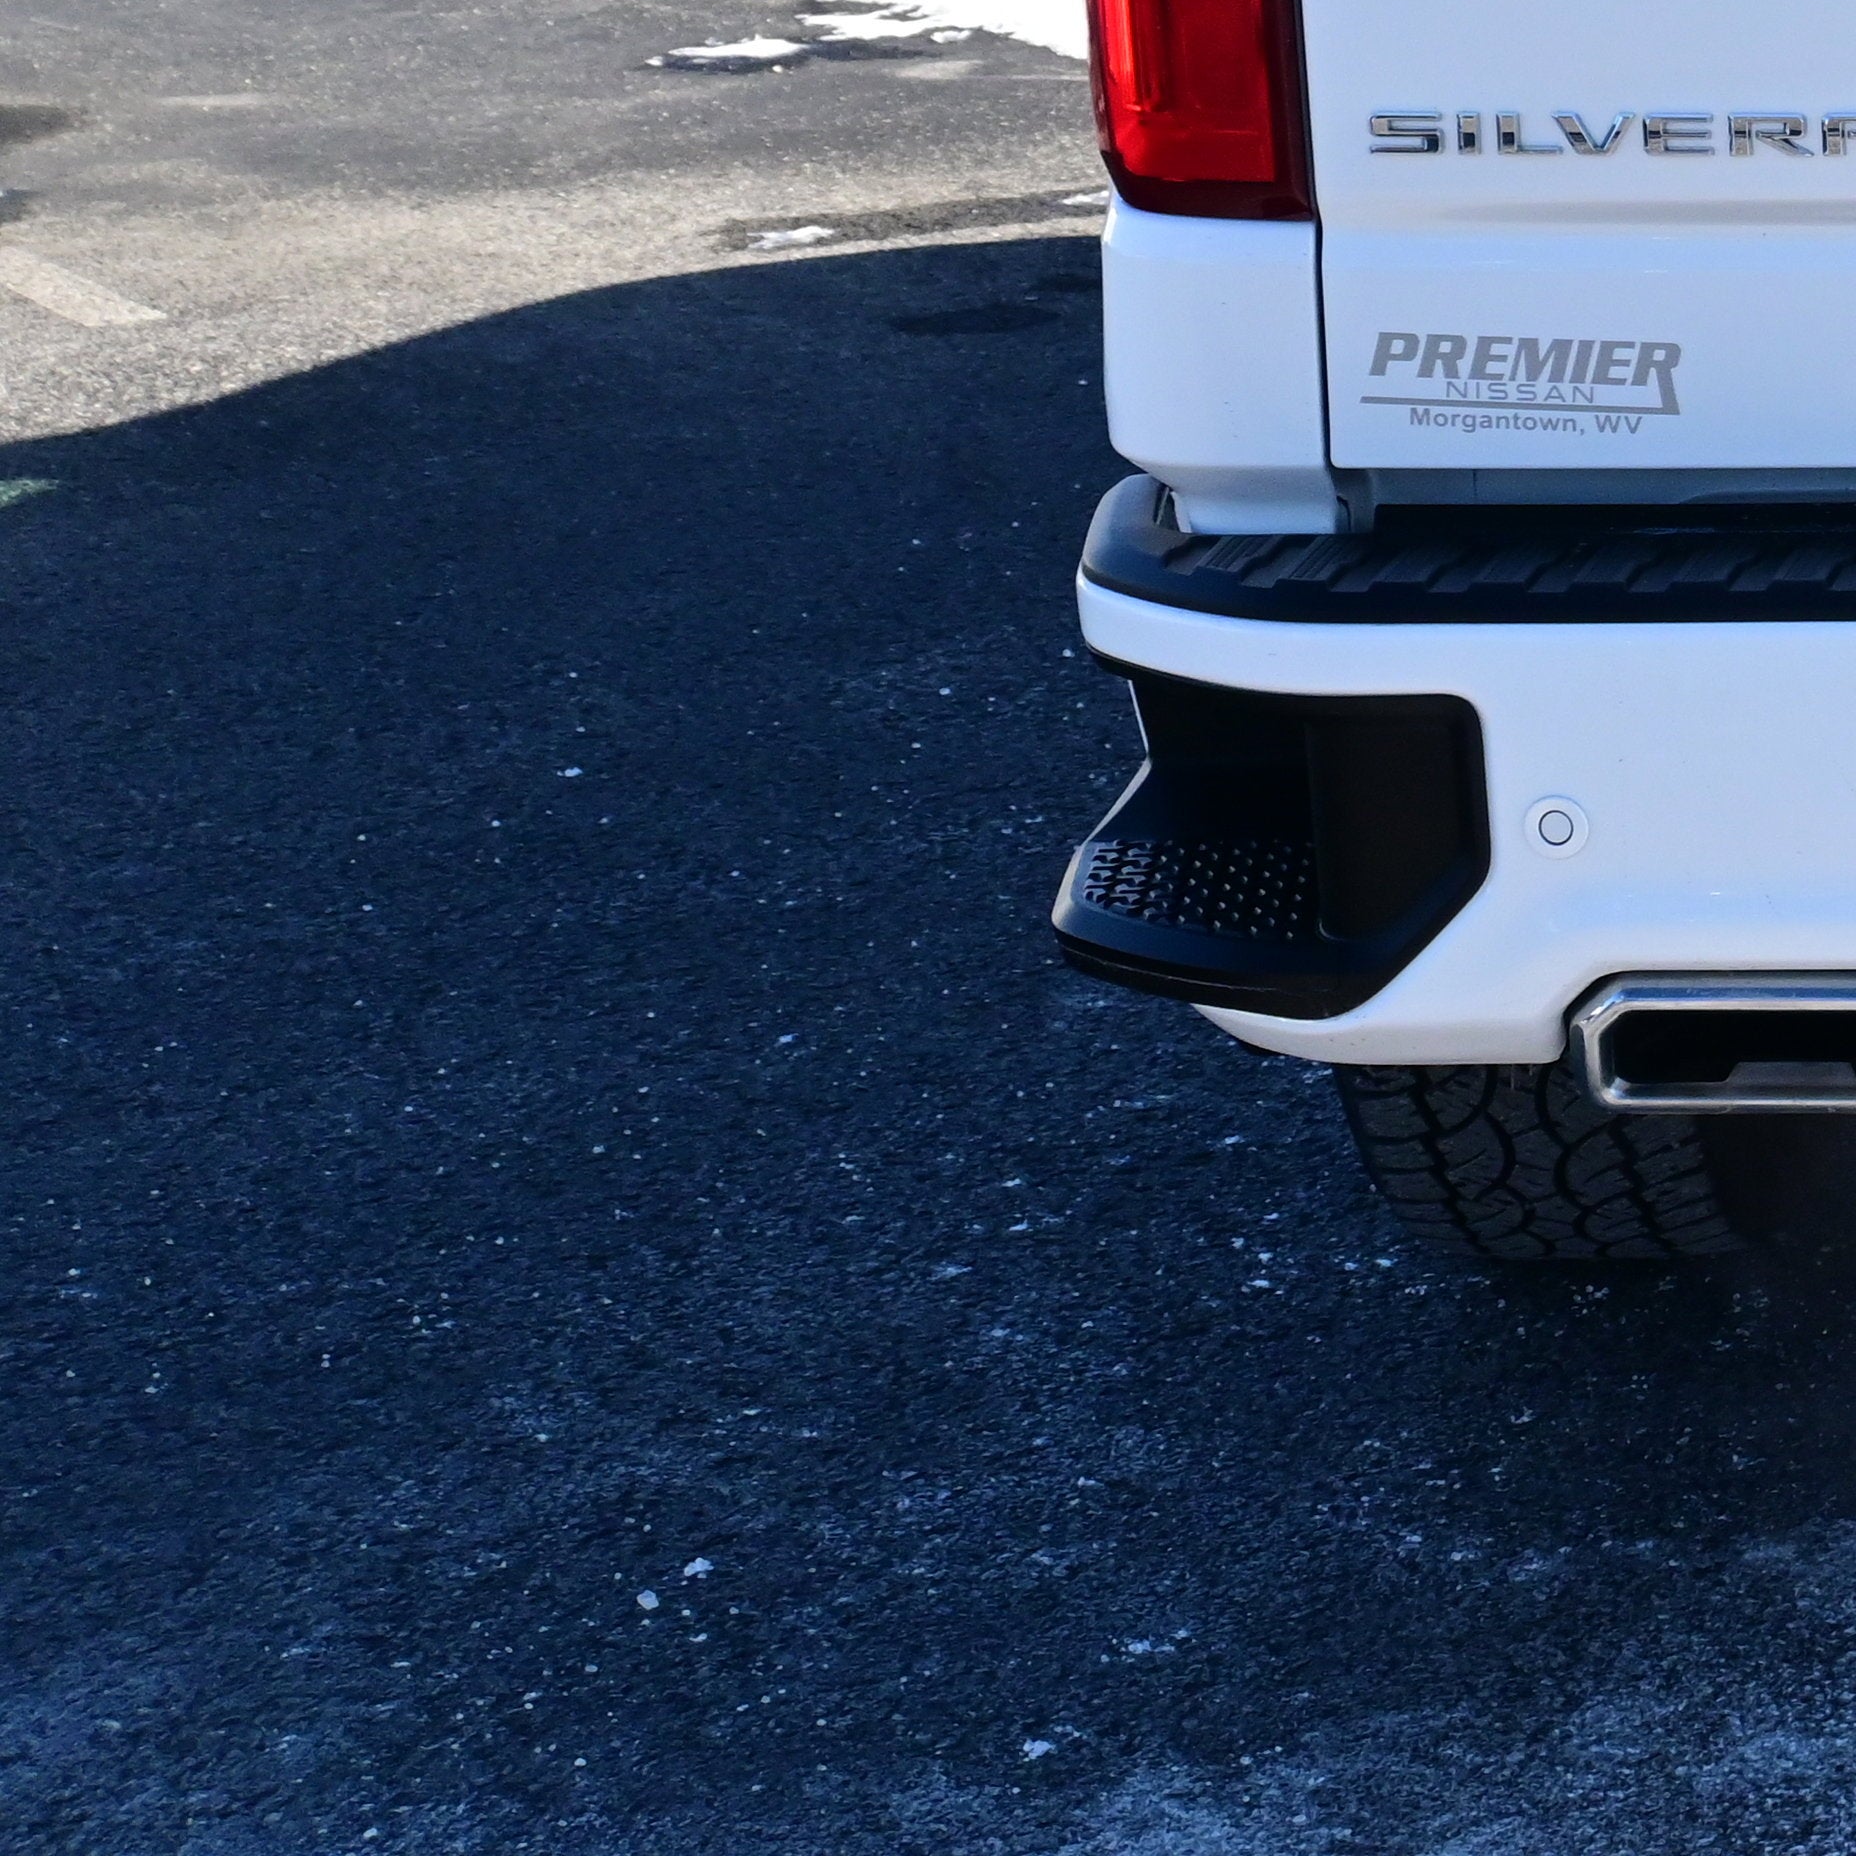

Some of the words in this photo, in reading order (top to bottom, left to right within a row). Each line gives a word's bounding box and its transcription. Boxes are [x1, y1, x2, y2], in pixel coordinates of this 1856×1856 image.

[1368, 331, 1682, 415] PREMIER
[1445, 380, 1596, 404] NISSAN
[1409, 406, 1588, 436] Morgantown,
[1594, 414, 1643, 435] WV
